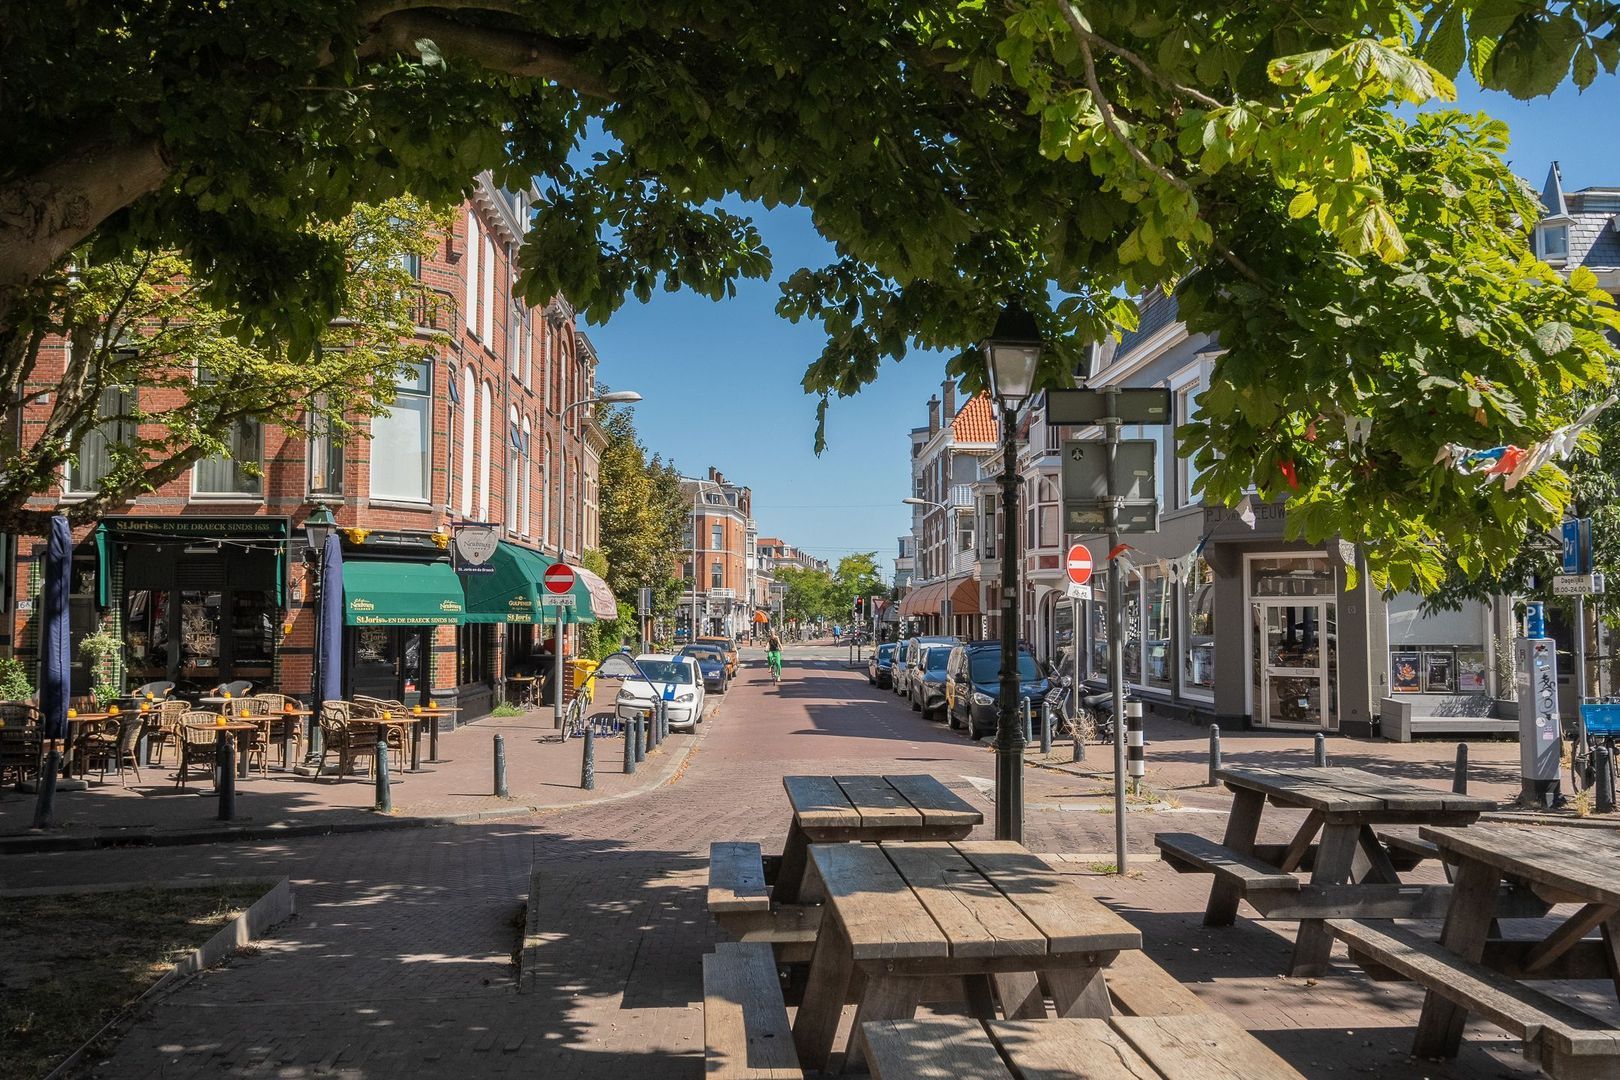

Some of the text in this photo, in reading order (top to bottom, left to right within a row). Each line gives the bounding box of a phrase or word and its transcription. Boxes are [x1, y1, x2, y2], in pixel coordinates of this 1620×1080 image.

[191, 523, 226, 531] DRAECK
[228, 523, 253, 531] SINDS
[1560, 577, 1584, 585] Dagelijks
[1527, 606, 1536, 619] P
